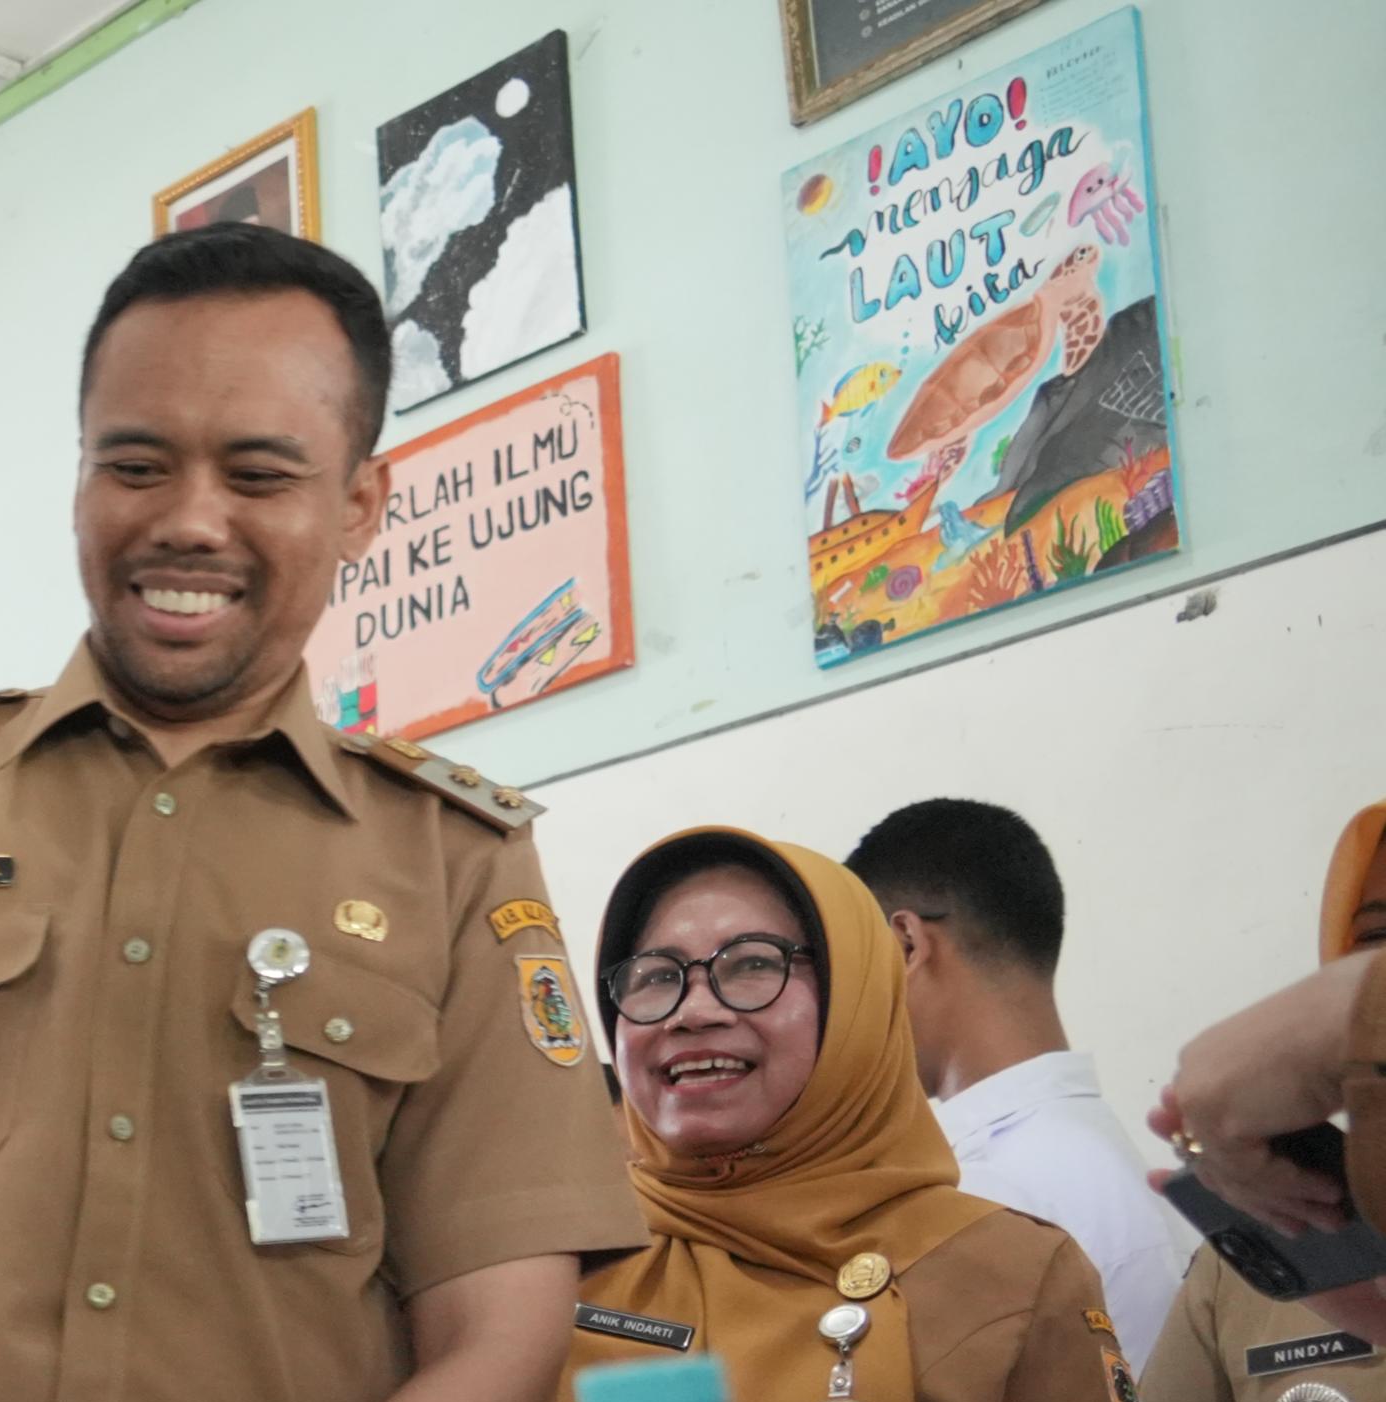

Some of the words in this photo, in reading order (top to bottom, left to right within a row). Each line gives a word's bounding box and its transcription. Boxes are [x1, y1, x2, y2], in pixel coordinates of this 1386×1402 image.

[819, 127, 1091, 260] menjaga
[850, 209, 1016, 323] LAUT
[935, 258, 1045, 353] kita
[378, 461, 473, 534] RLAH
[493, 419, 578, 486] ILMU
[330, 549, 390, 607] PAI
[407, 524, 453, 577] KE
[469, 470, 593, 550] UJUNG
[356, 575, 470, 649] DUNIA
[589, 1312, 621, 1328] ANIK
[623, 1320, 674, 1339] INDARTI
[1274, 1340, 1344, 1363] NINDYA
